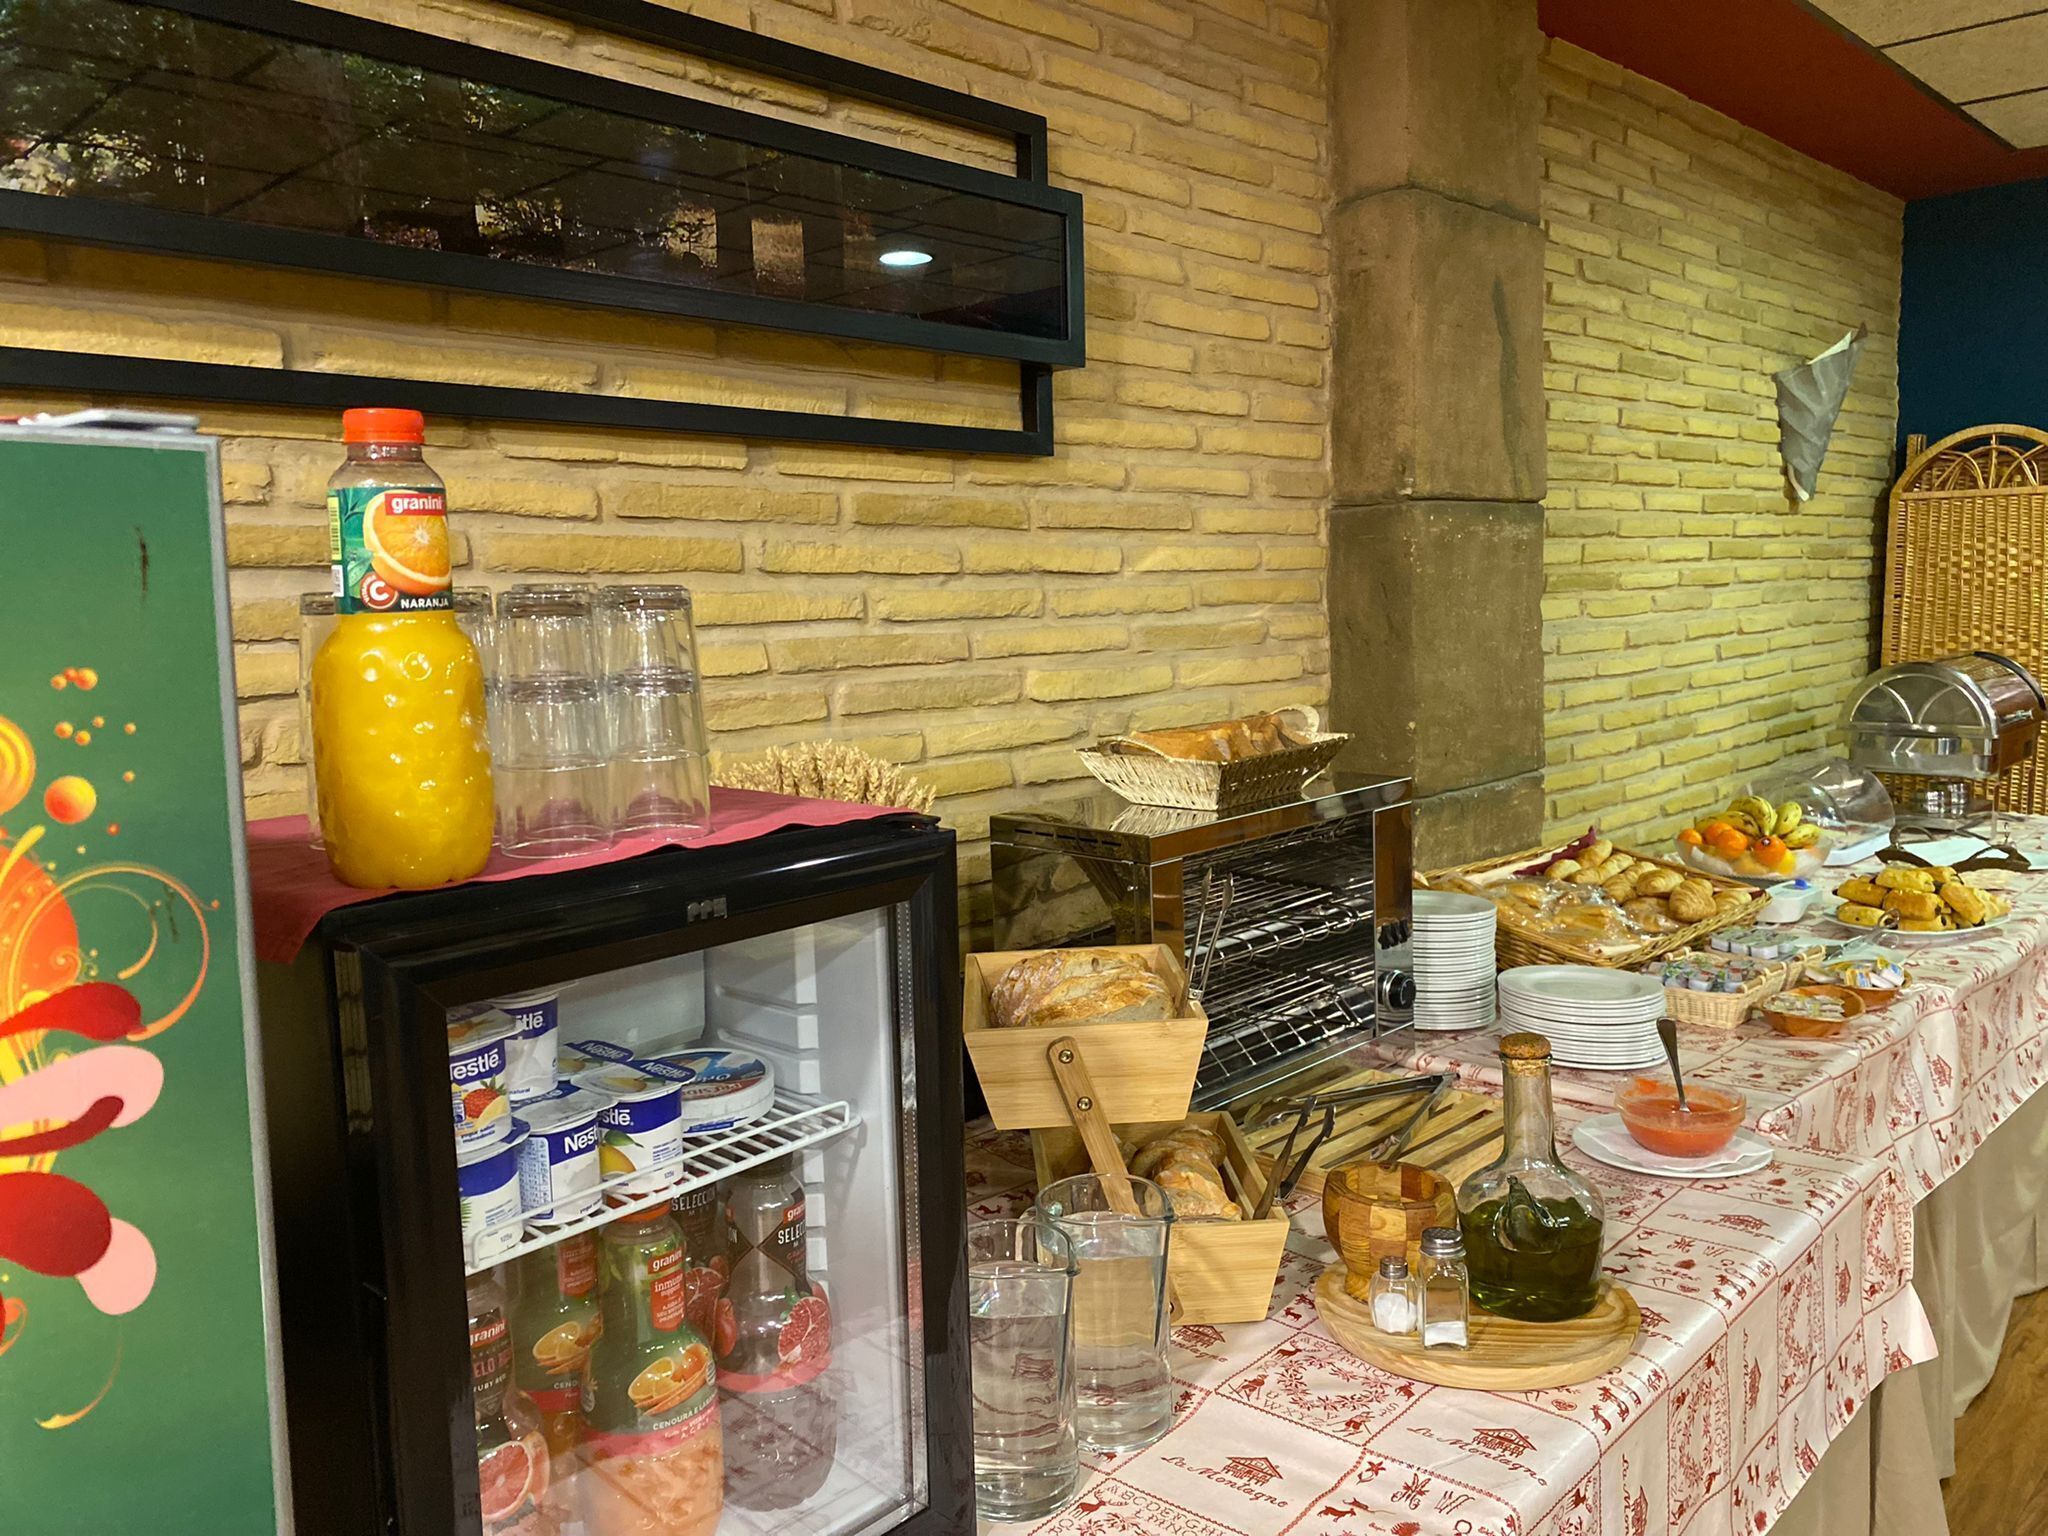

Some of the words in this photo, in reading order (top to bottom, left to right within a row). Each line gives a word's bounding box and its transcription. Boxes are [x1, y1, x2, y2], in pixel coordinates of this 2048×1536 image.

[391, 496, 442, 513] granini
[369, 580, 390, 602] C
[400, 598, 449, 609] NARANJA
[601, 1108, 631, 1127] stlé
[563, 1125, 598, 1154] Nest
[652, 1409, 694, 1431] CENOURA
[1436, 1437, 1548, 1487] Montagne
[1160, 1456, 1187, 1469] La
[1186, 1466, 1289, 1508] Montagne
